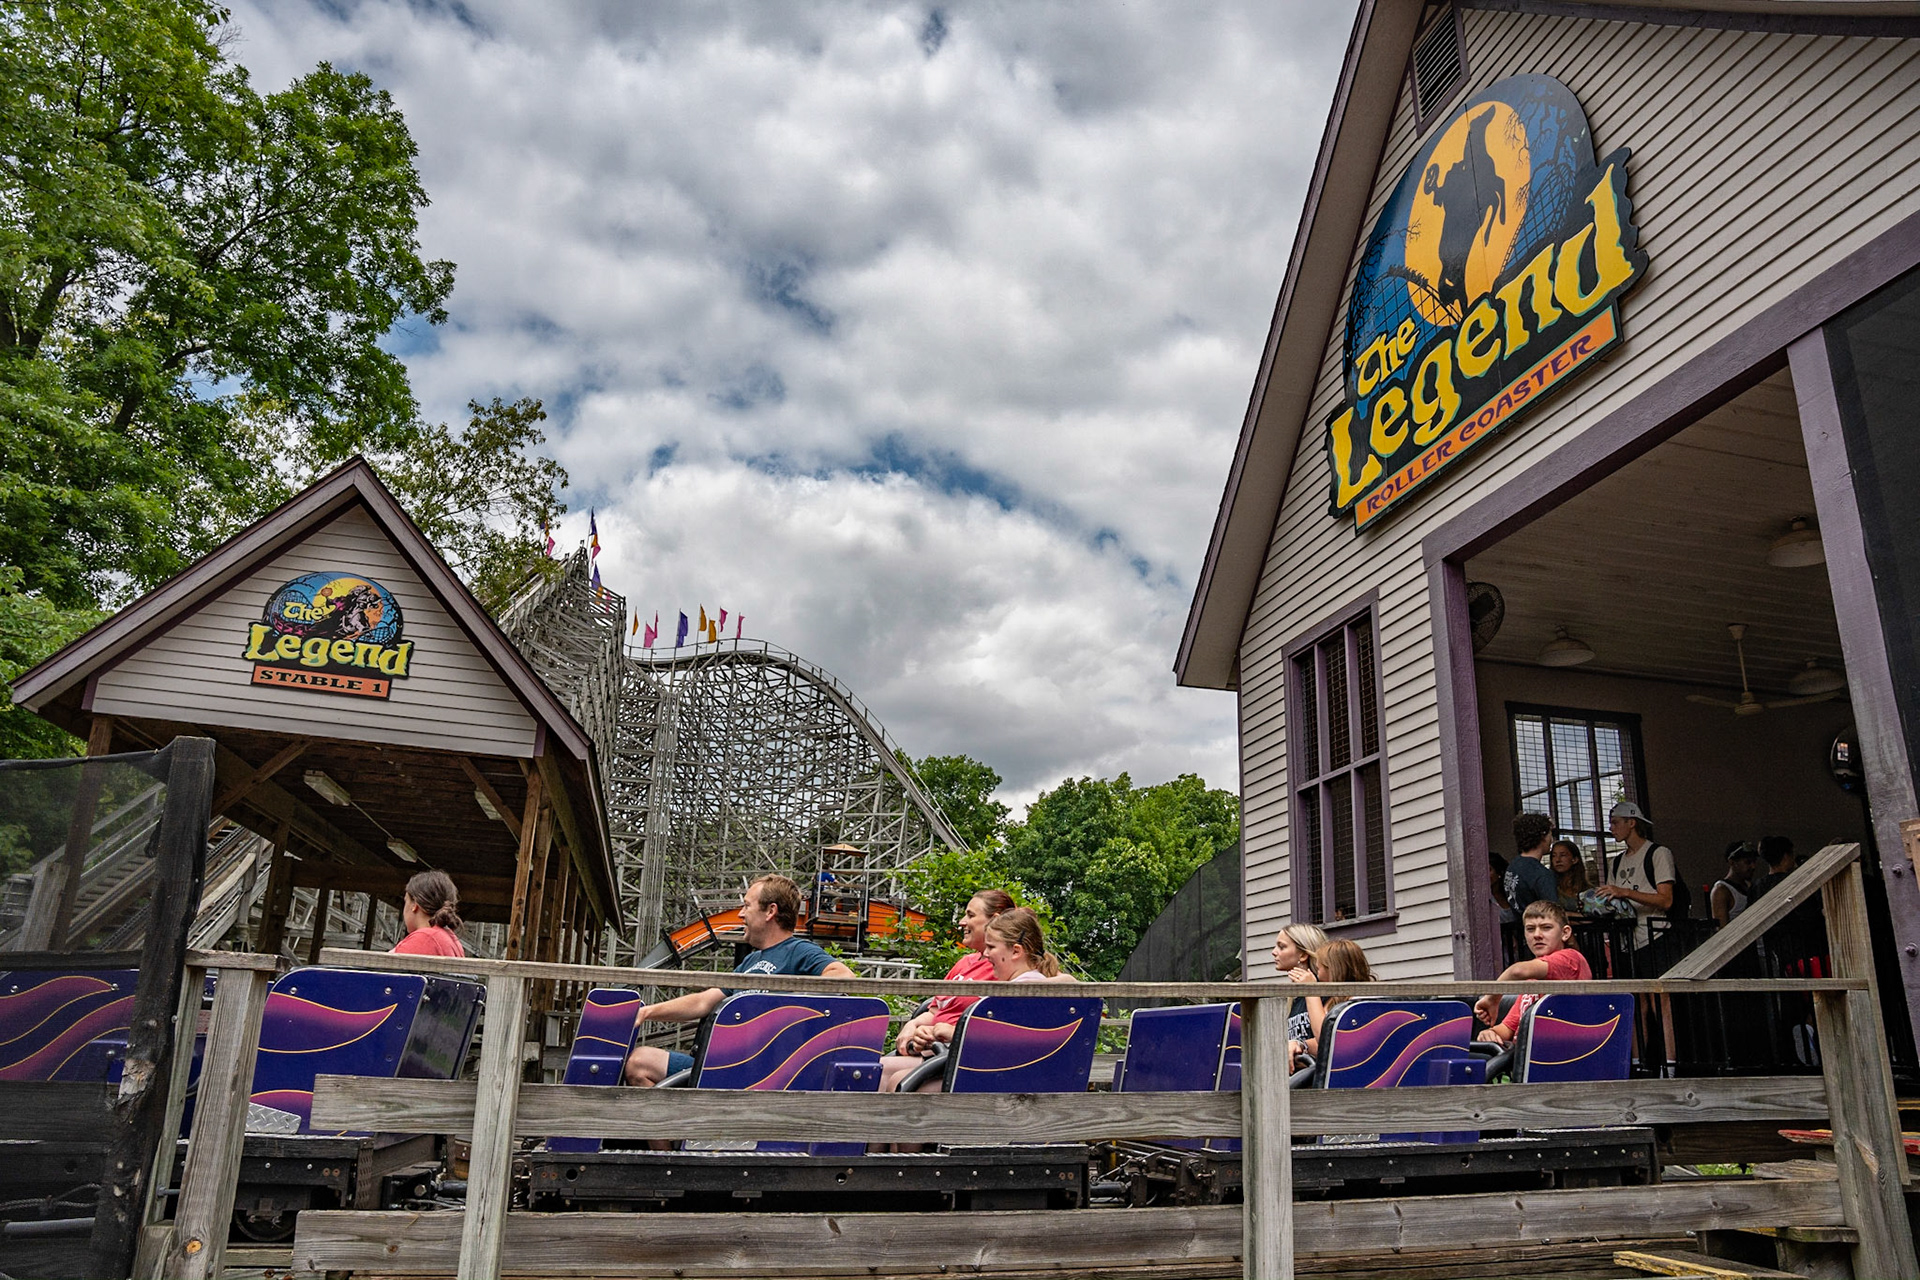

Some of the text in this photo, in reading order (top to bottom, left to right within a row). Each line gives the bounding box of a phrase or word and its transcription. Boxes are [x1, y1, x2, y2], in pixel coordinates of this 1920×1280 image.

[1330, 163, 1635, 509] Legend
[1355, 317, 1420, 397] The
[1366, 334, 1596, 514] ROLLER COASTER
[283, 601, 324, 621] The
[245, 624, 412, 677] Legend
[260, 669, 382, 693] STABLE 1
